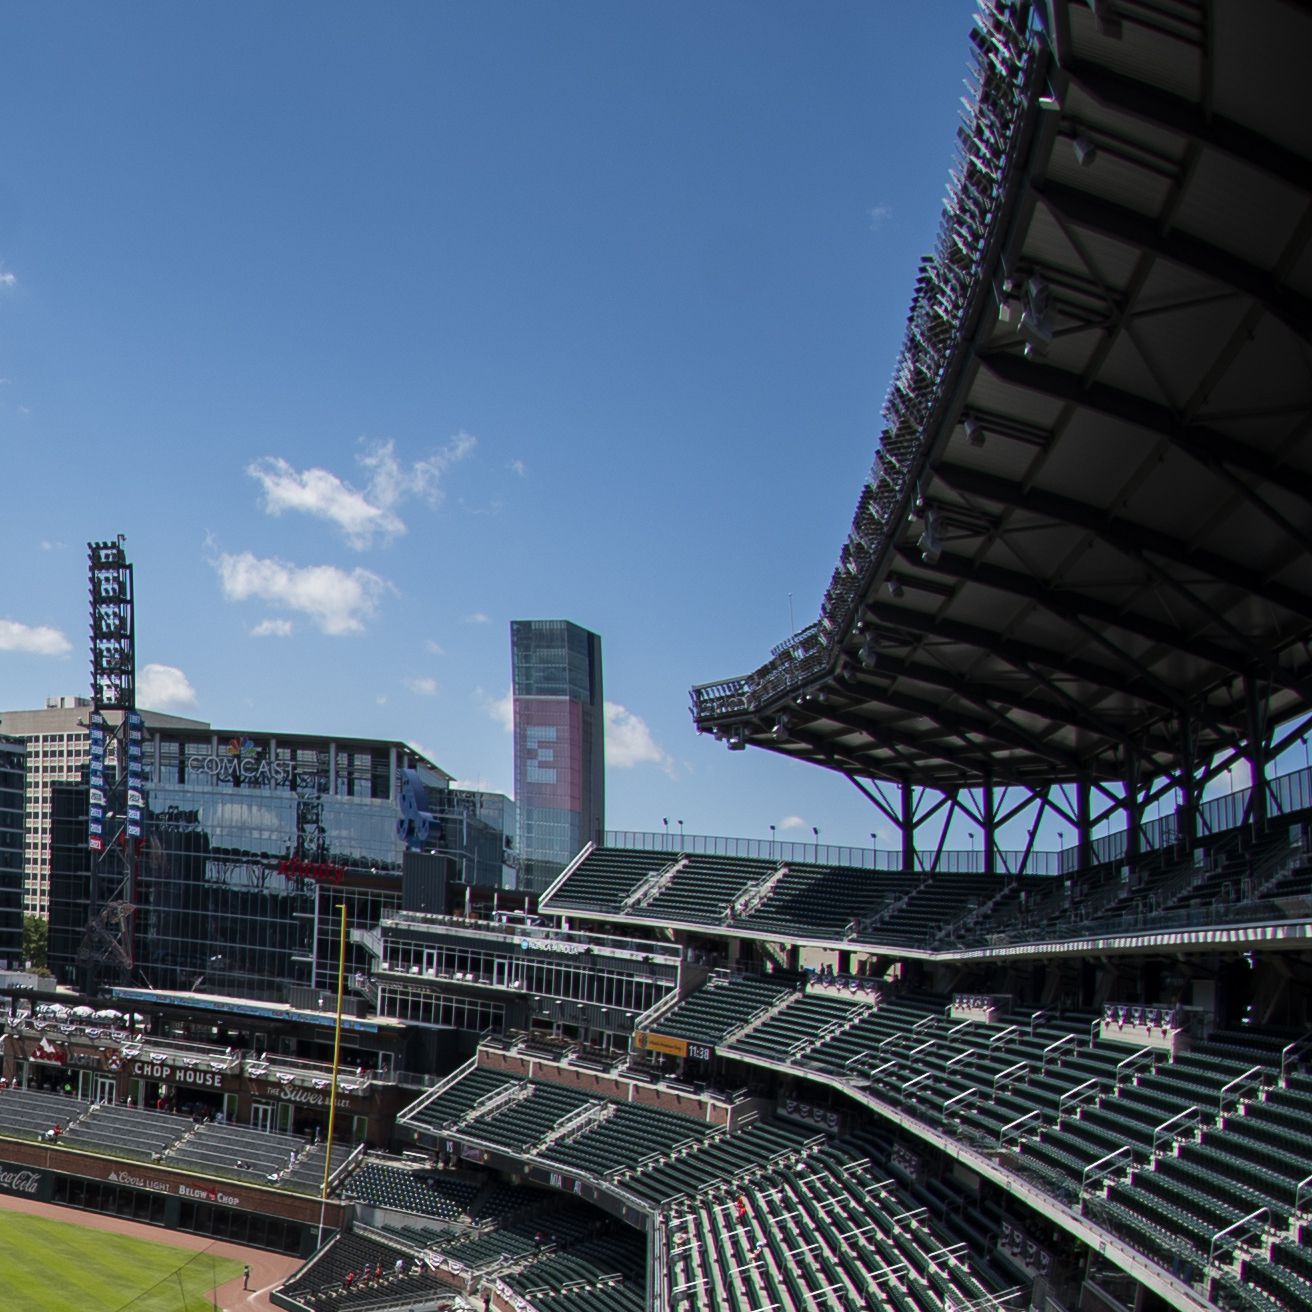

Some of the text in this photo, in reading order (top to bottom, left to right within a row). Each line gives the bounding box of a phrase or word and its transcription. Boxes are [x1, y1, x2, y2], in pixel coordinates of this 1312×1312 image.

[188, 755, 296, 779] COMCAST
[134, 1062, 223, 1087] CHOP HOUSE
[267, 1083, 324, 1106] THE Silver
[145, 1179, 170, 1192] LIGHT
[178, 1184, 240, 1206] BELOW CHOP
